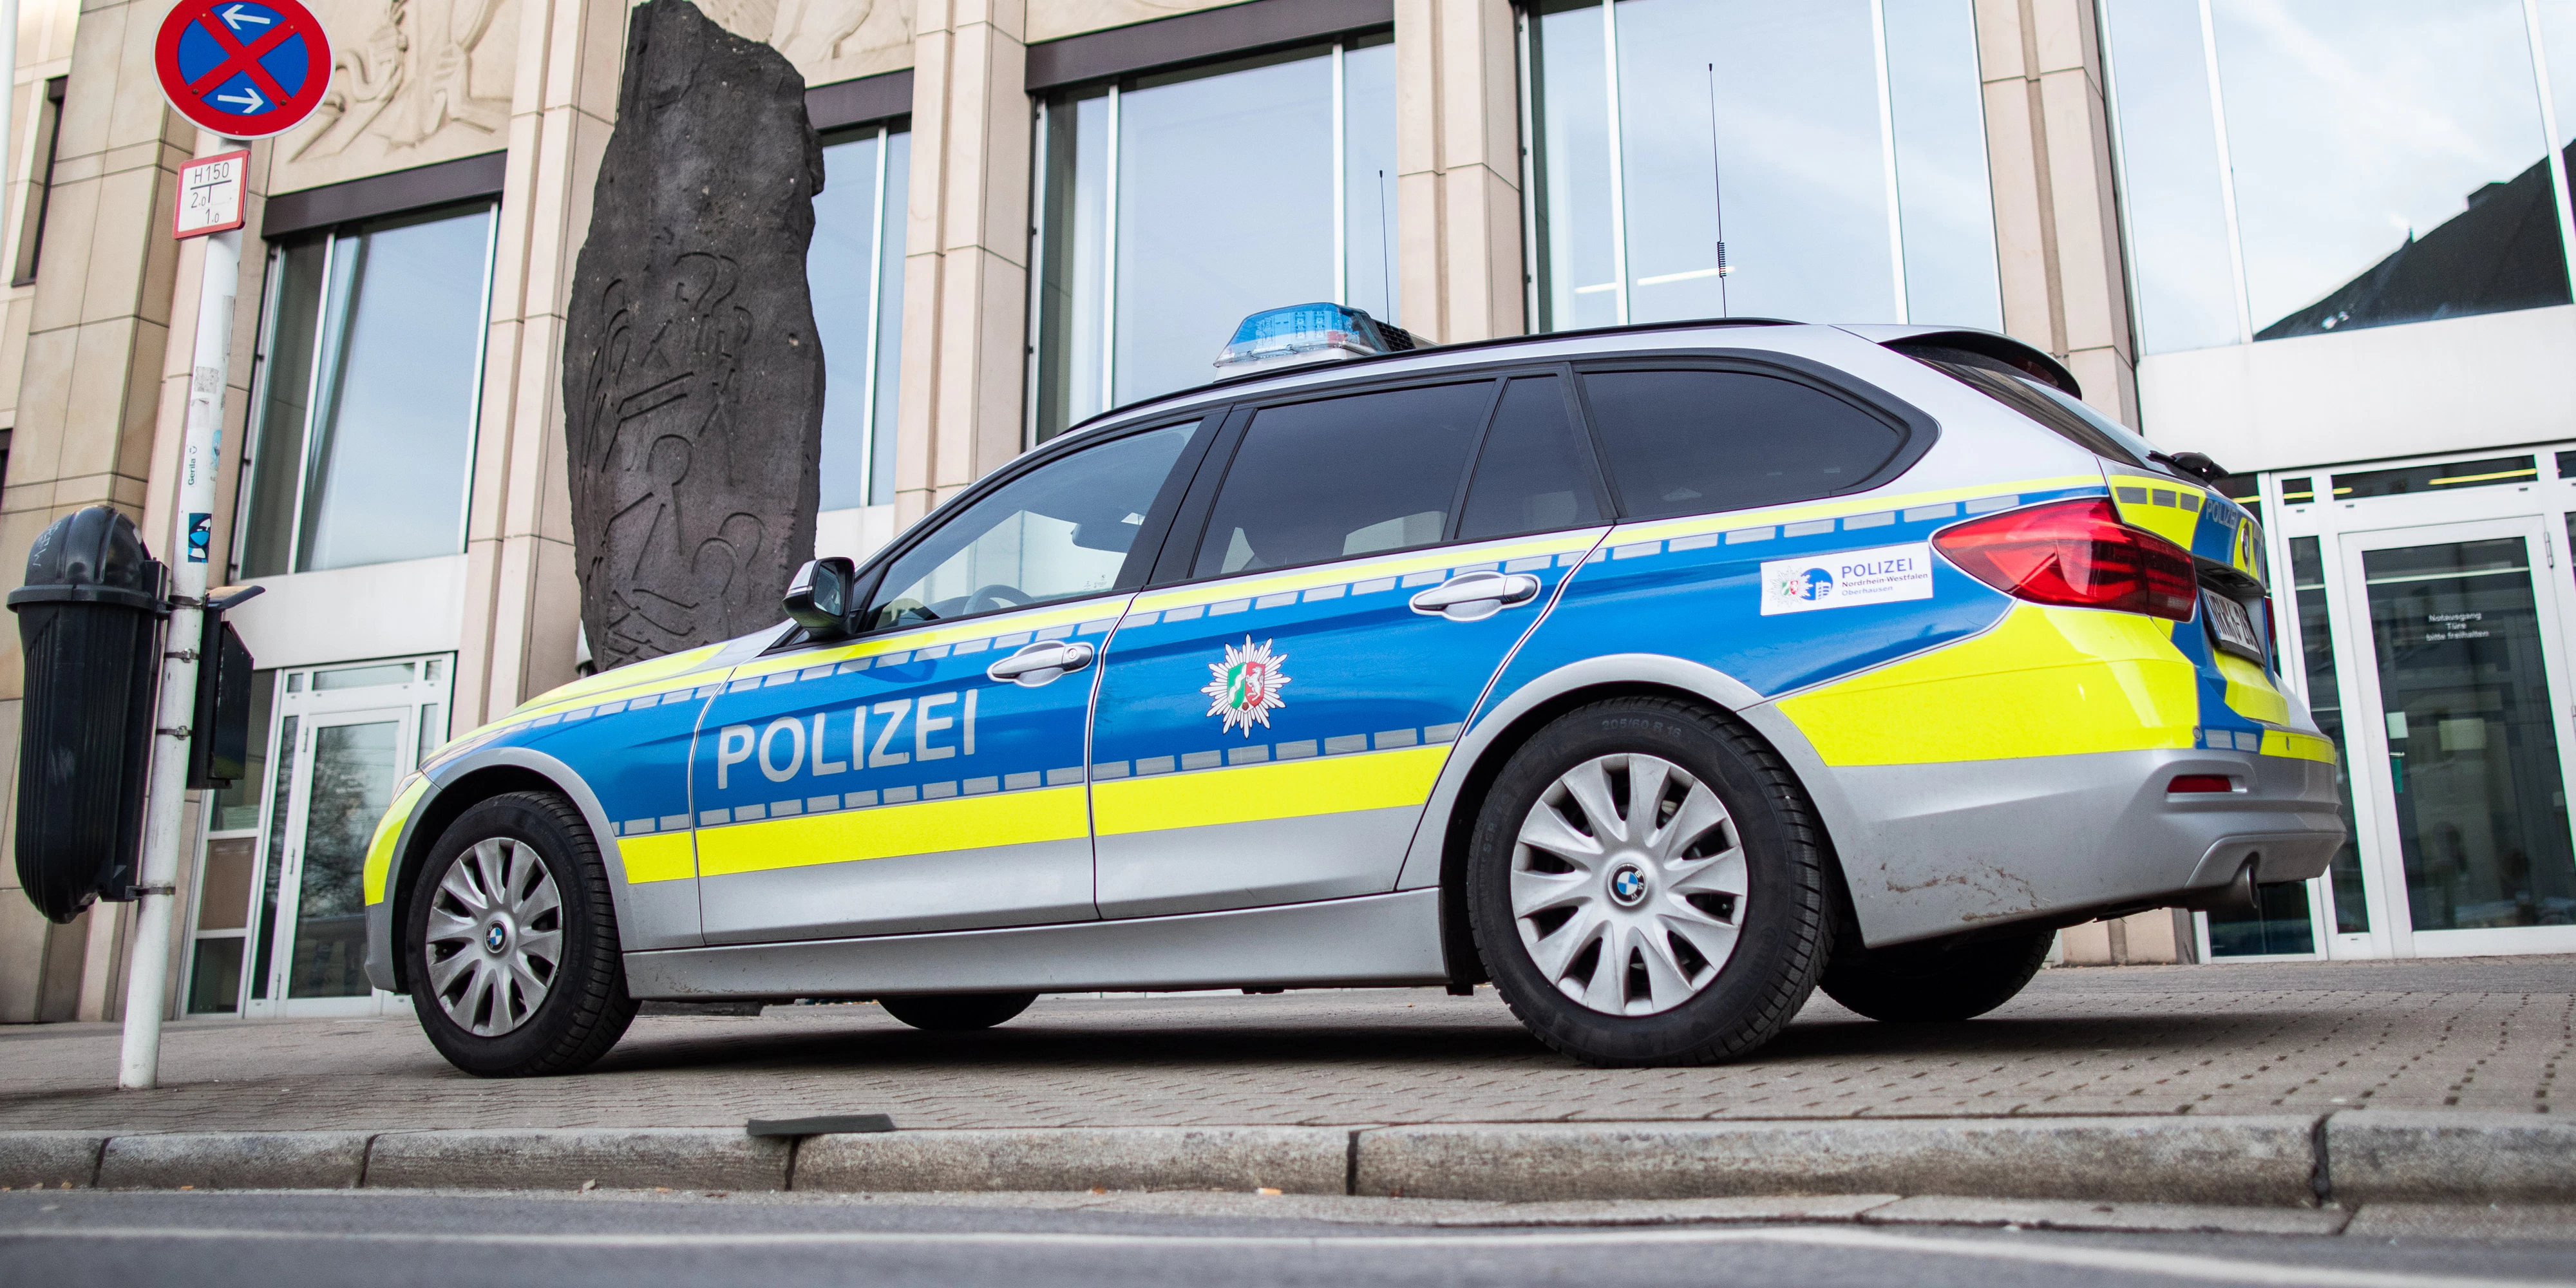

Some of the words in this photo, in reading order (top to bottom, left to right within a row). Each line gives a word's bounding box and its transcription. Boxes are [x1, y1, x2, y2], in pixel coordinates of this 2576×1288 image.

[194, 162, 229, 184] H150
[2206, 499, 2238, 530] POLIZEI
[1841, 558, 1913, 579] POLIZEI
[1842, 573, 1928, 587] Nordrhein-Westfalen
[1841, 586, 1893, 596] Oberhausen
[2429, 612, 2482, 623] Notausgang
[2426, 633, 2446, 641] bitte
[2447, 630, 2490, 639] freihalten
[1602, 718, 1649, 730] 205/60
[717, 689, 978, 790] POLIZEI
